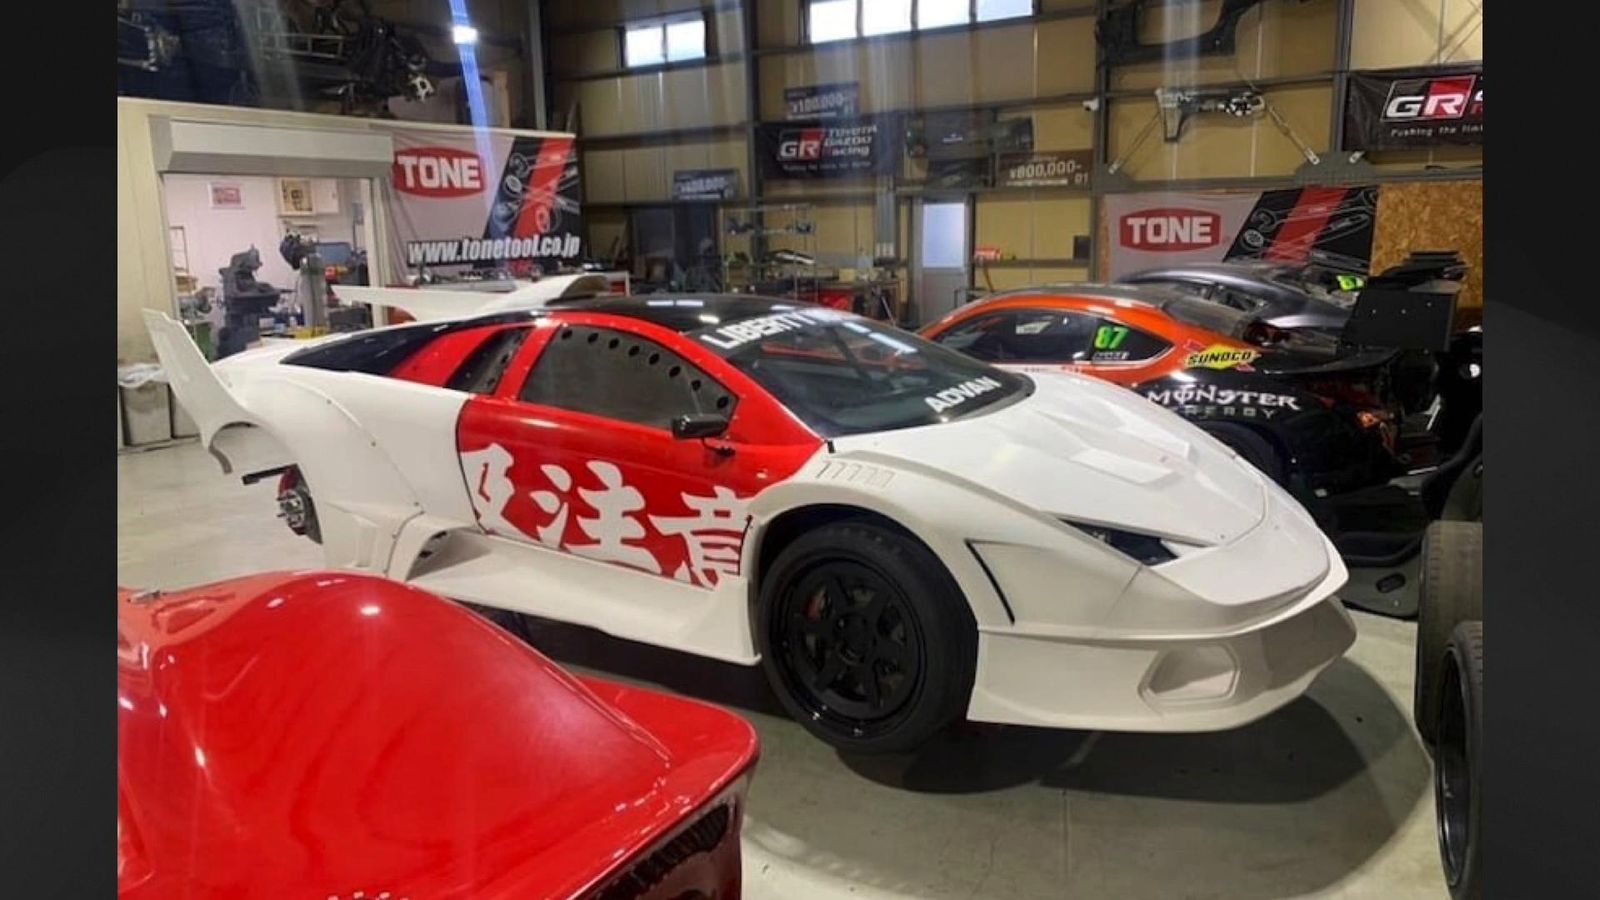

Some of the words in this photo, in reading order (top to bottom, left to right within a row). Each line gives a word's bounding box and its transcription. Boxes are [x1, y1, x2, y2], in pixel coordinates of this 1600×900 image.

[1386, 93, 1465, 117] GR
[780, 139, 820, 159] GR
[397, 155, 482, 189] TONE
[1126, 216, 1213, 244] TONE
[408, 233, 581, 265] www.tonetool.co.jp
[1094, 326, 1129, 350] 87
[1188, 350, 1254, 366] SUNOCO
[924, 376, 1003, 413] ADVAN
[1147, 384, 1301, 411] MONSTER
